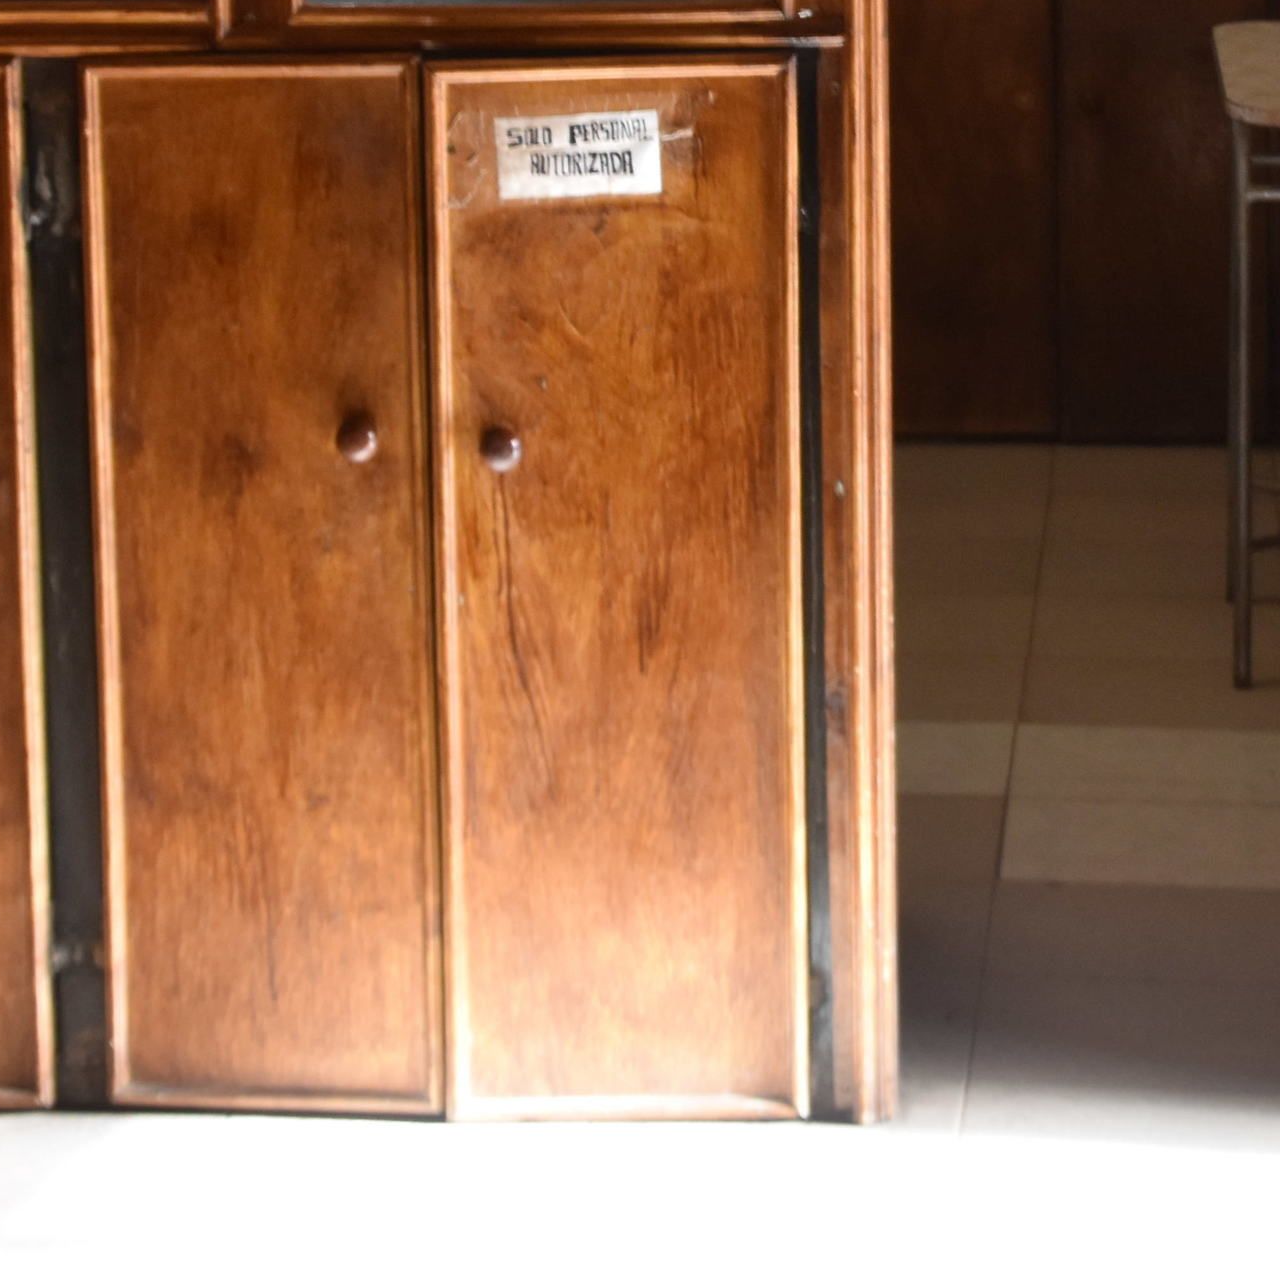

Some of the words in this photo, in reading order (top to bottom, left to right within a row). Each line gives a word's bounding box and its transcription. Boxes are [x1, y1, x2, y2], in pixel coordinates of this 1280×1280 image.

[506, 126, 553, 148] SOLO
[569, 118, 653, 145] PERSONAL
[530, 150, 634, 176] AUTORIZADA
